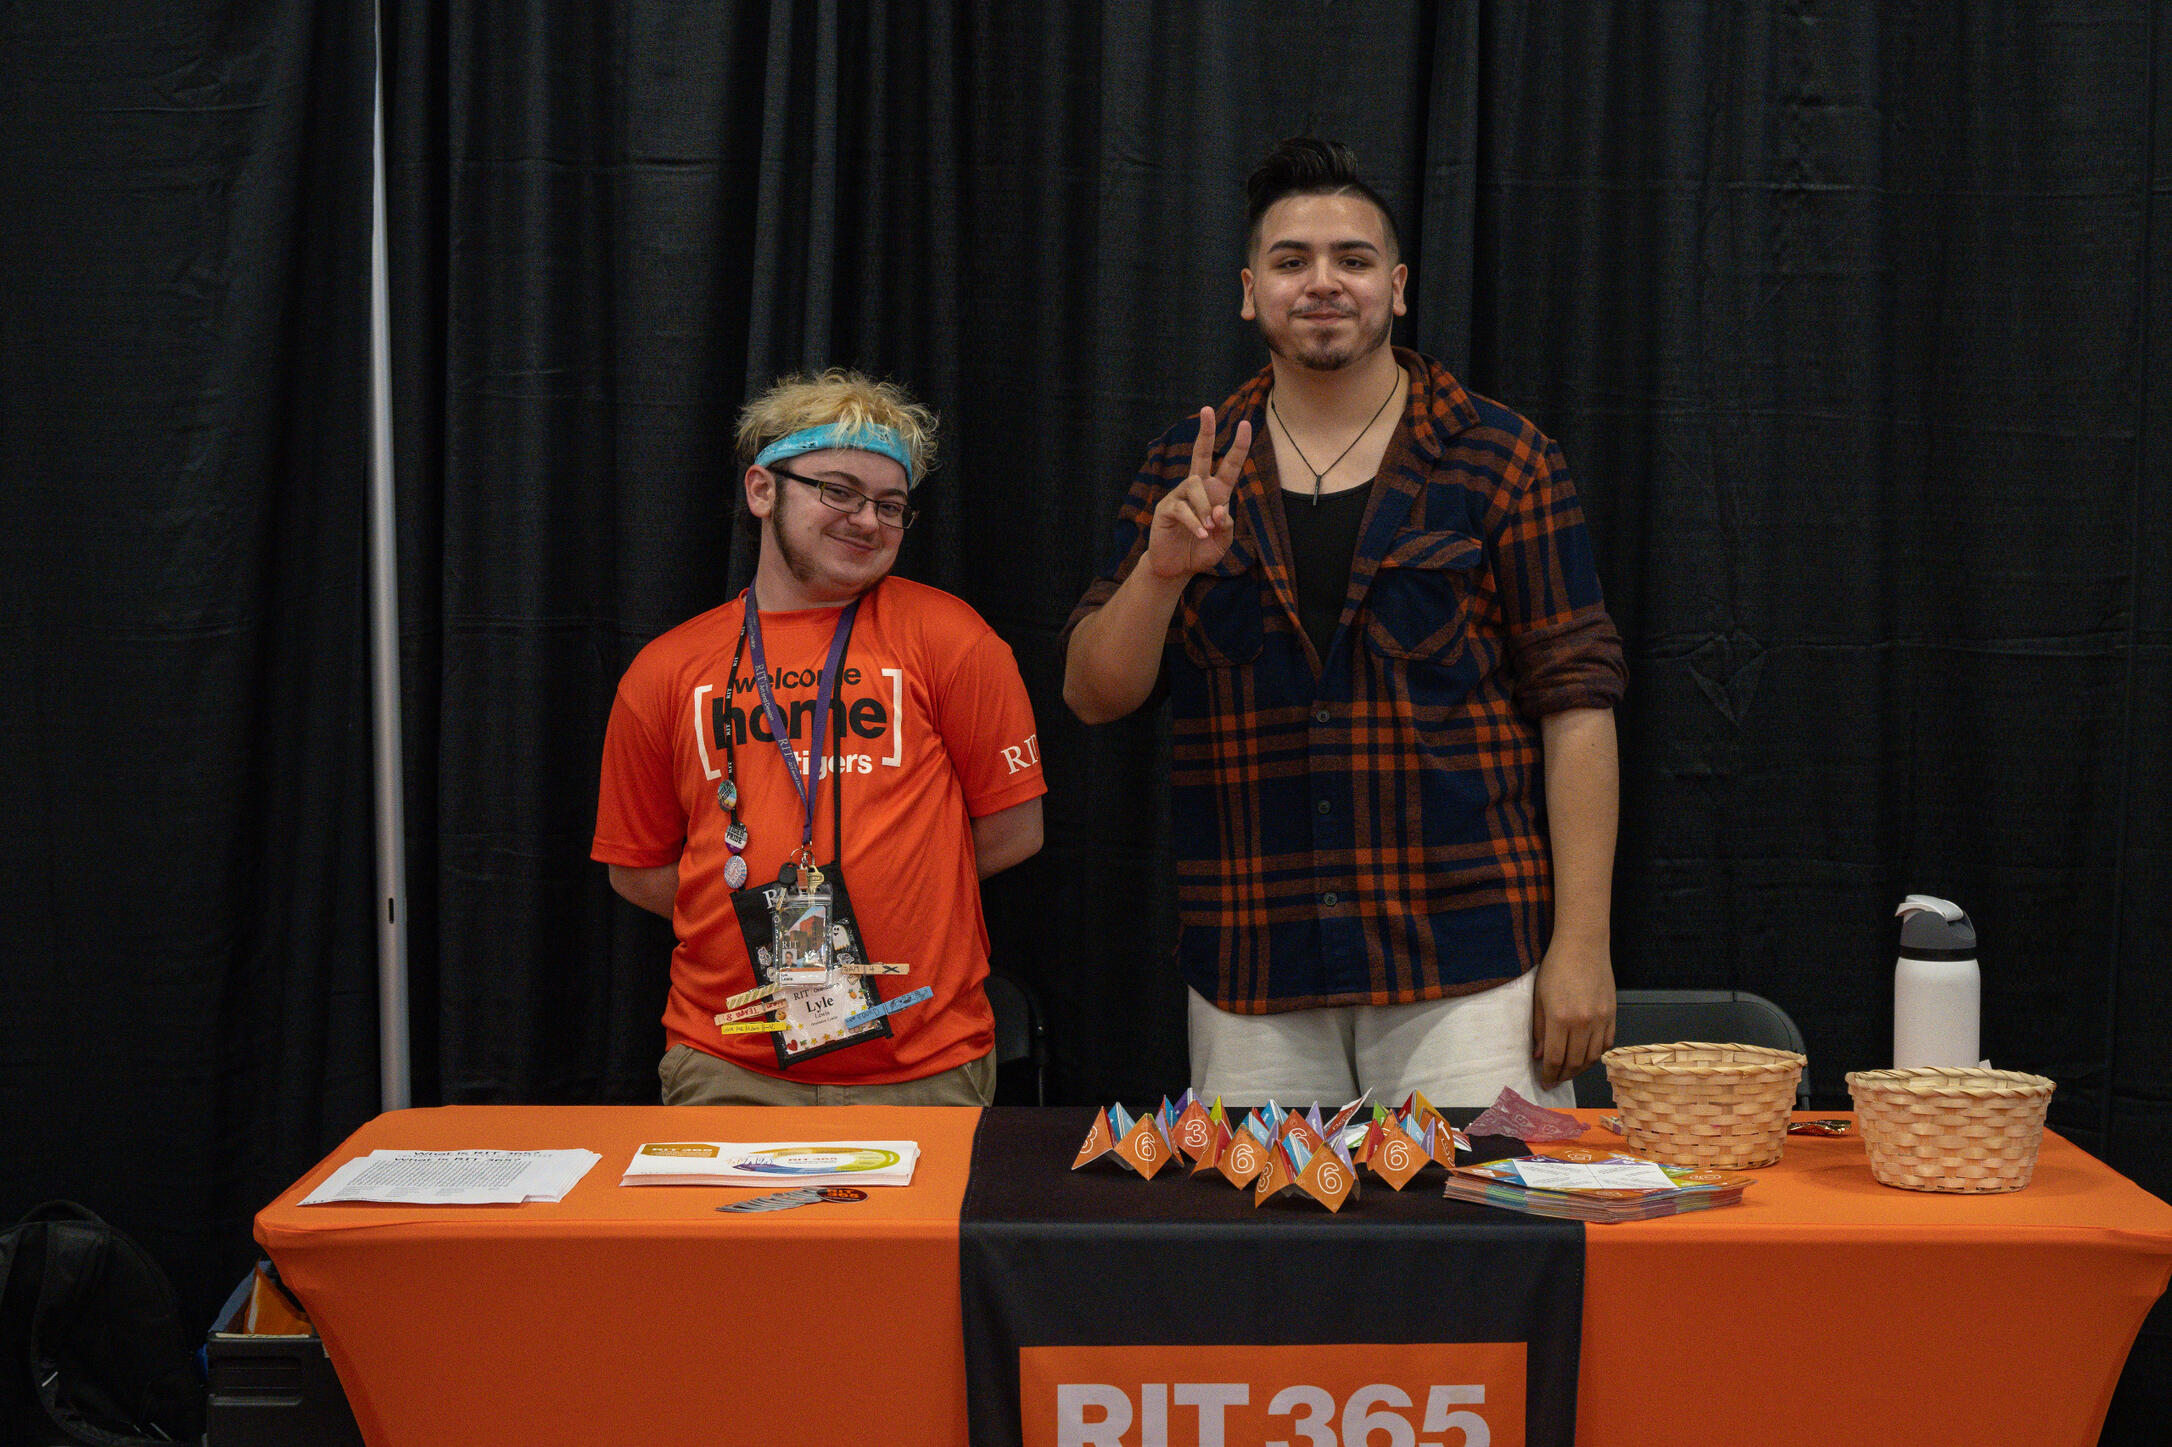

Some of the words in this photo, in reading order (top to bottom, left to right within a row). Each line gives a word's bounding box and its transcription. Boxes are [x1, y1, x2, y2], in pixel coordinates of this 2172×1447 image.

[735, 667, 862, 694] wlcoe
[754, 664, 767, 681] RIT
[712, 697, 888, 750] home
[780, 738, 794, 759] RIT
[793, 989, 810, 1000] RIT
[806, 997, 834, 1013] Lyle
[1135, 1131, 1157, 1161] 6
[1185, 1119, 1209, 1148] 3
[1231, 1143, 1255, 1174] 6
[1383, 1140, 1410, 1171] 6
[1317, 1162, 1343, 1195] 6
[1057, 1383, 1250, 1447] RIT
[1265, 1383, 1491, 1447] 365
